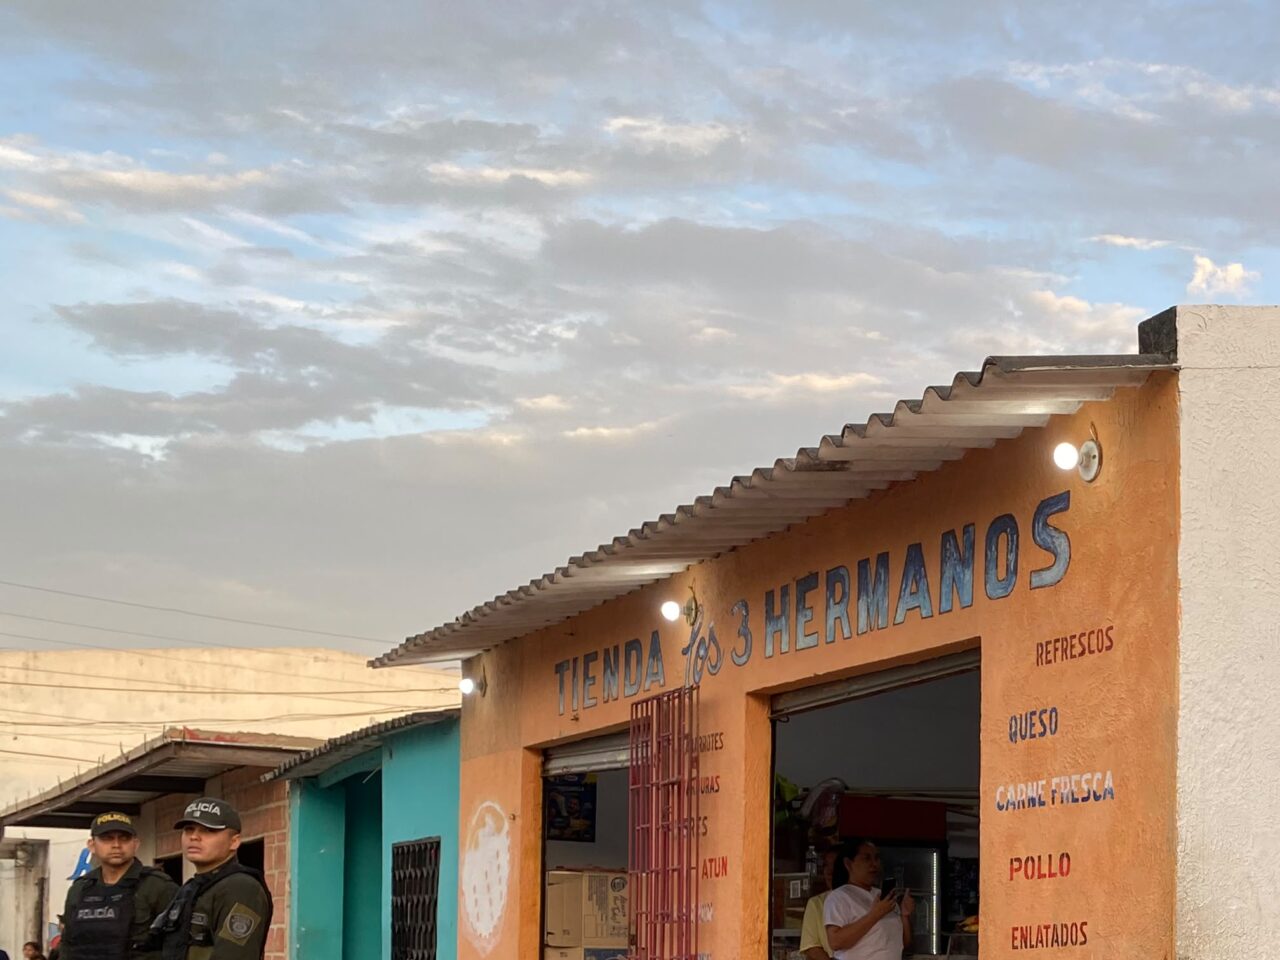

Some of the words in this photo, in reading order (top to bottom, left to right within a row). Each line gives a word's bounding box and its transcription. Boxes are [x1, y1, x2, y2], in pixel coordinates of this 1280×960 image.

[555, 629, 666, 716] TIENDA
[731, 599, 752, 667] 3
[765, 490, 1071, 659] HERMANOS
[1036, 626, 1114, 667] REFRESCOS
[1008, 706, 1059, 744] QUESO
[995, 778, 1047, 811] CARNE
[1051, 770, 1115, 805] FRESCA
[701, 856, 728, 880] ATUN
[1009, 852, 1071, 881] POLLO
[1011, 921, 1087, 950] ENLATADOS
